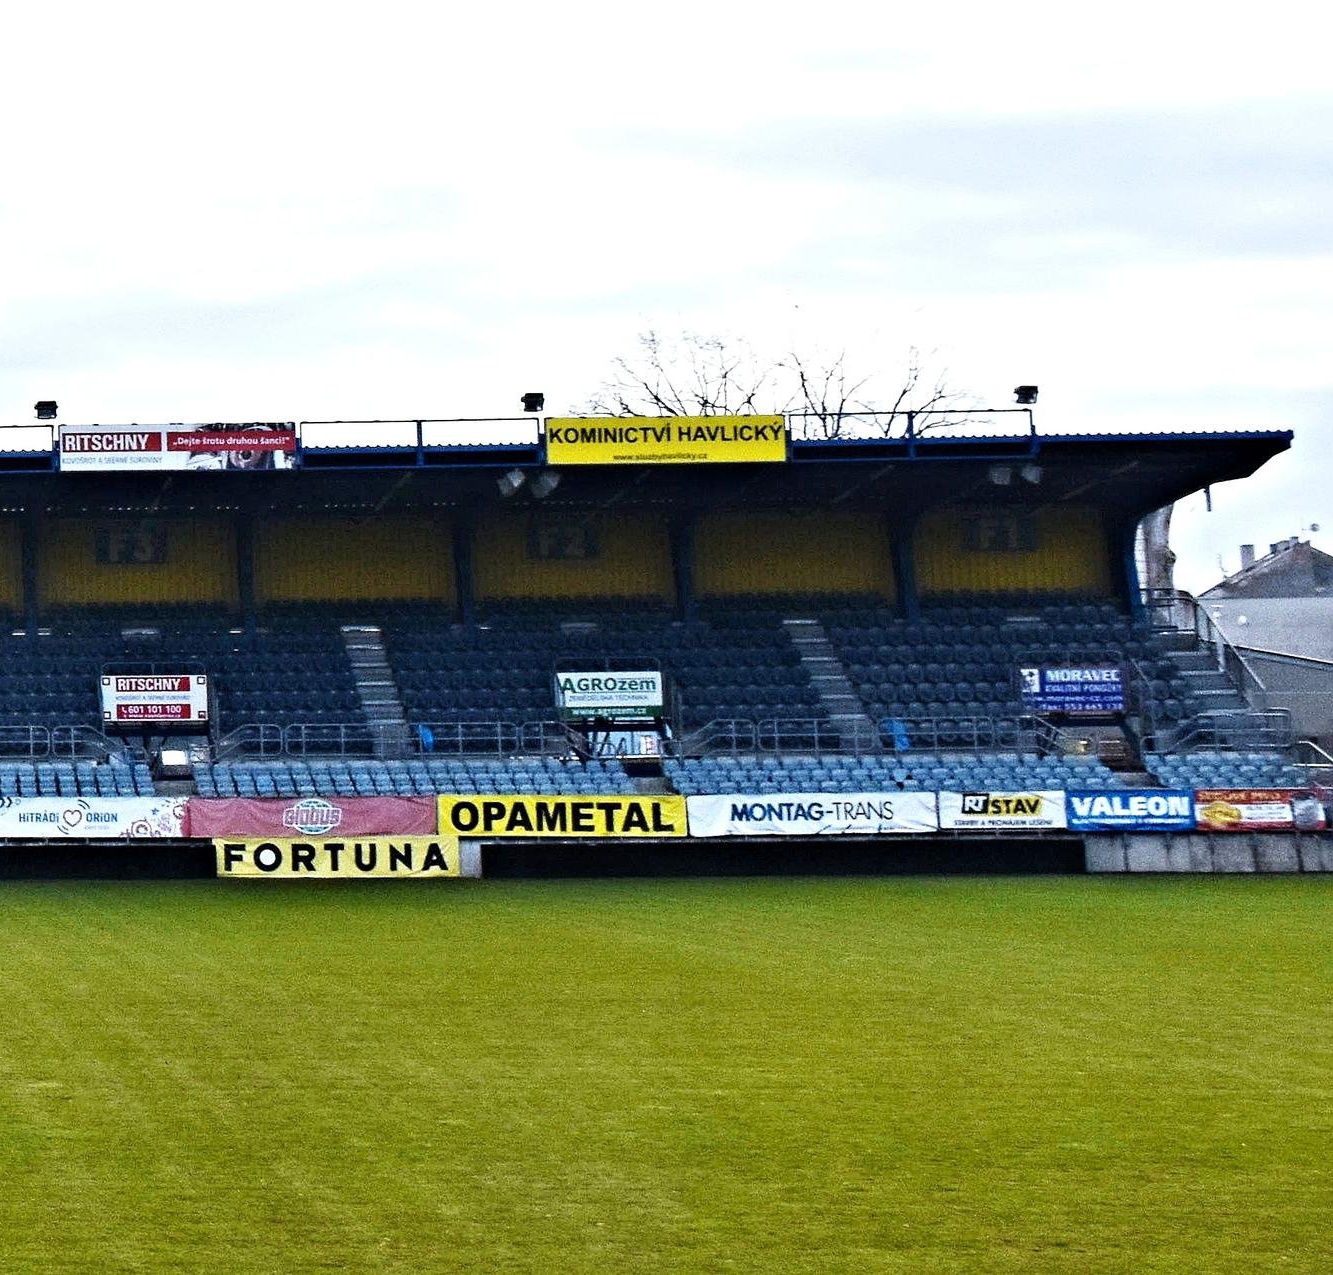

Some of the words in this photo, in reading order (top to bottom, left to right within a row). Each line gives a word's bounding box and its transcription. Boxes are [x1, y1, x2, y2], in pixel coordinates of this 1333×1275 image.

[64, 433, 150, 450] RITSCHNY
[226, 436, 258, 445] druhou
[549, 423, 671, 443] KOMINICTVÍ
[678, 422, 783, 442] HAVLICKÝ
[539, 526, 585, 557] F2
[117, 678, 181, 691] RITSCHNY
[127, 705, 144, 714] 601
[147, 705, 163, 714] 101
[165, 705, 182, 714] 100
[450, 801, 675, 833] OPAMETAL
[730, 801, 894, 822] MONTAG-TRANS
[990, 798, 1041, 815] STAV
[1071, 796, 1190, 817] VALEON
[223, 842, 449, 872] FORTUNA
